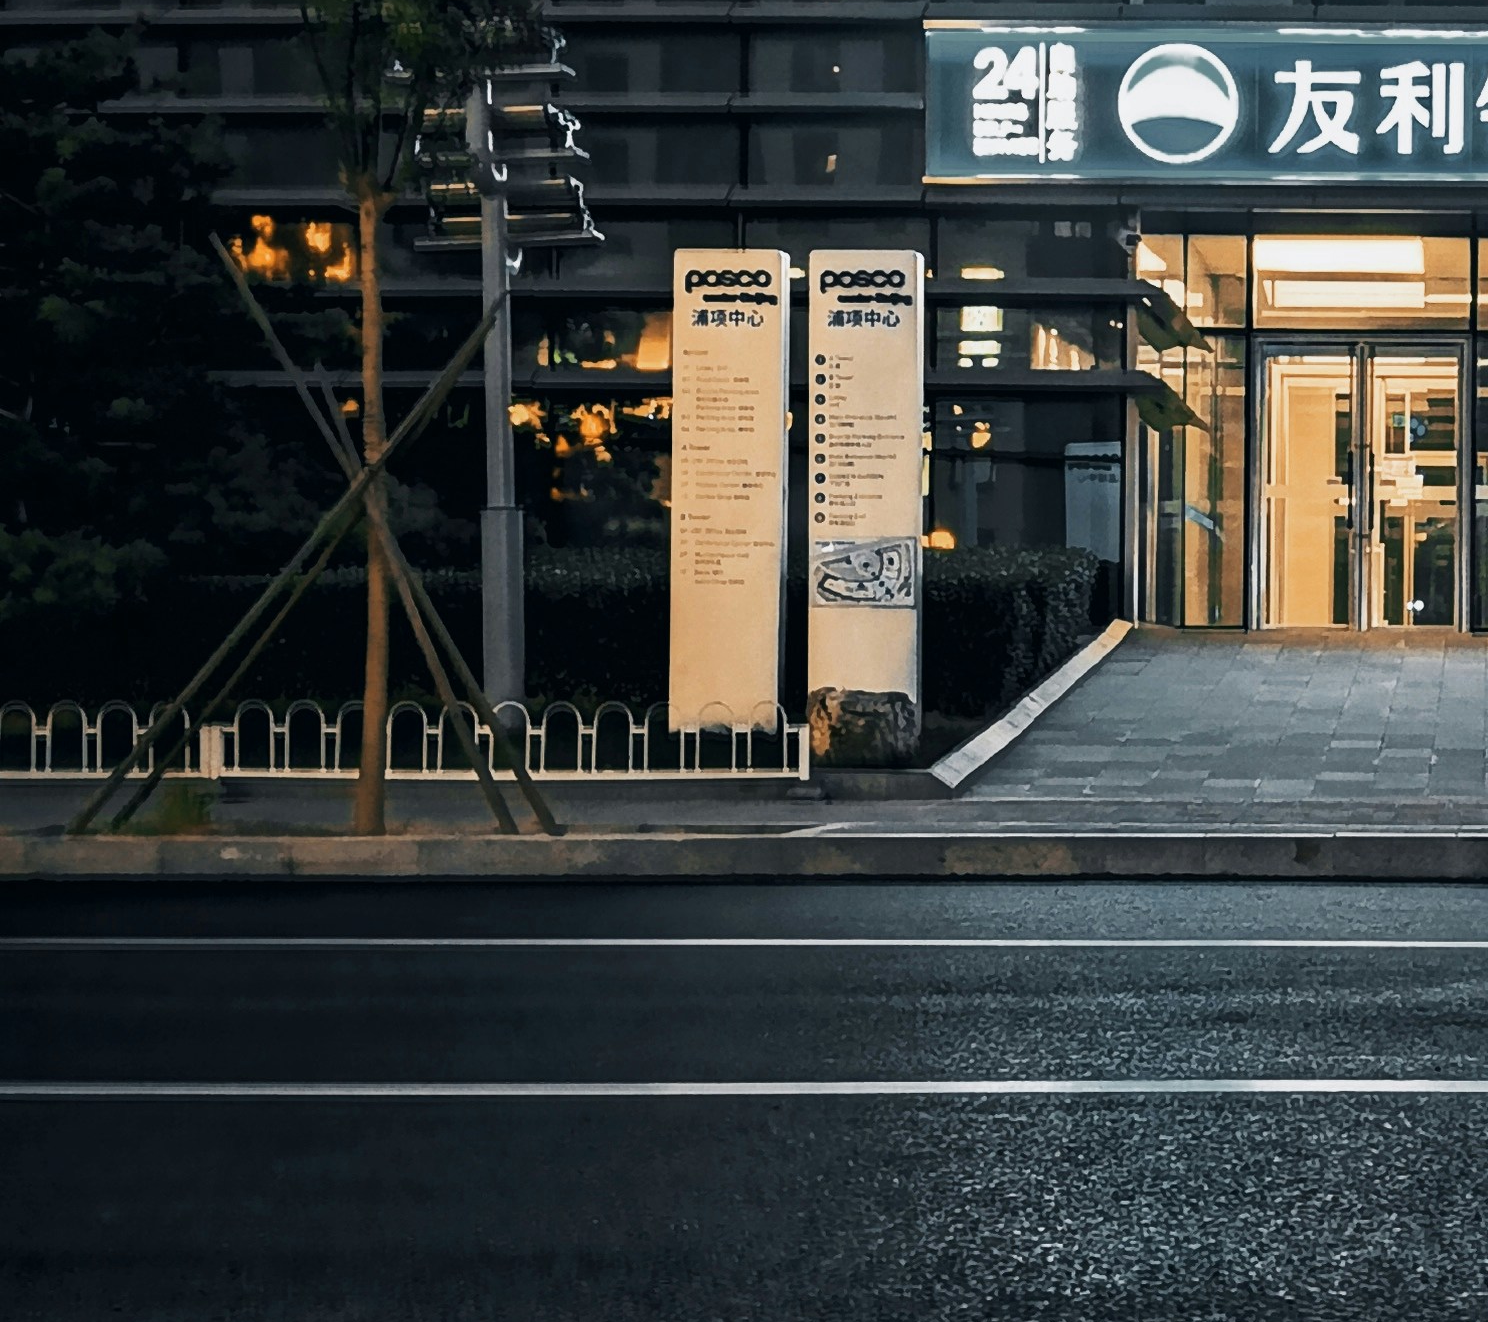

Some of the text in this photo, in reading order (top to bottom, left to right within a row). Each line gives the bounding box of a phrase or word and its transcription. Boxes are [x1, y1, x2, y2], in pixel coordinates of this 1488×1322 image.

[972, 46, 1039, 100] 24
[685, 269, 772, 294] posco
[820, 269, 905, 294] posco
